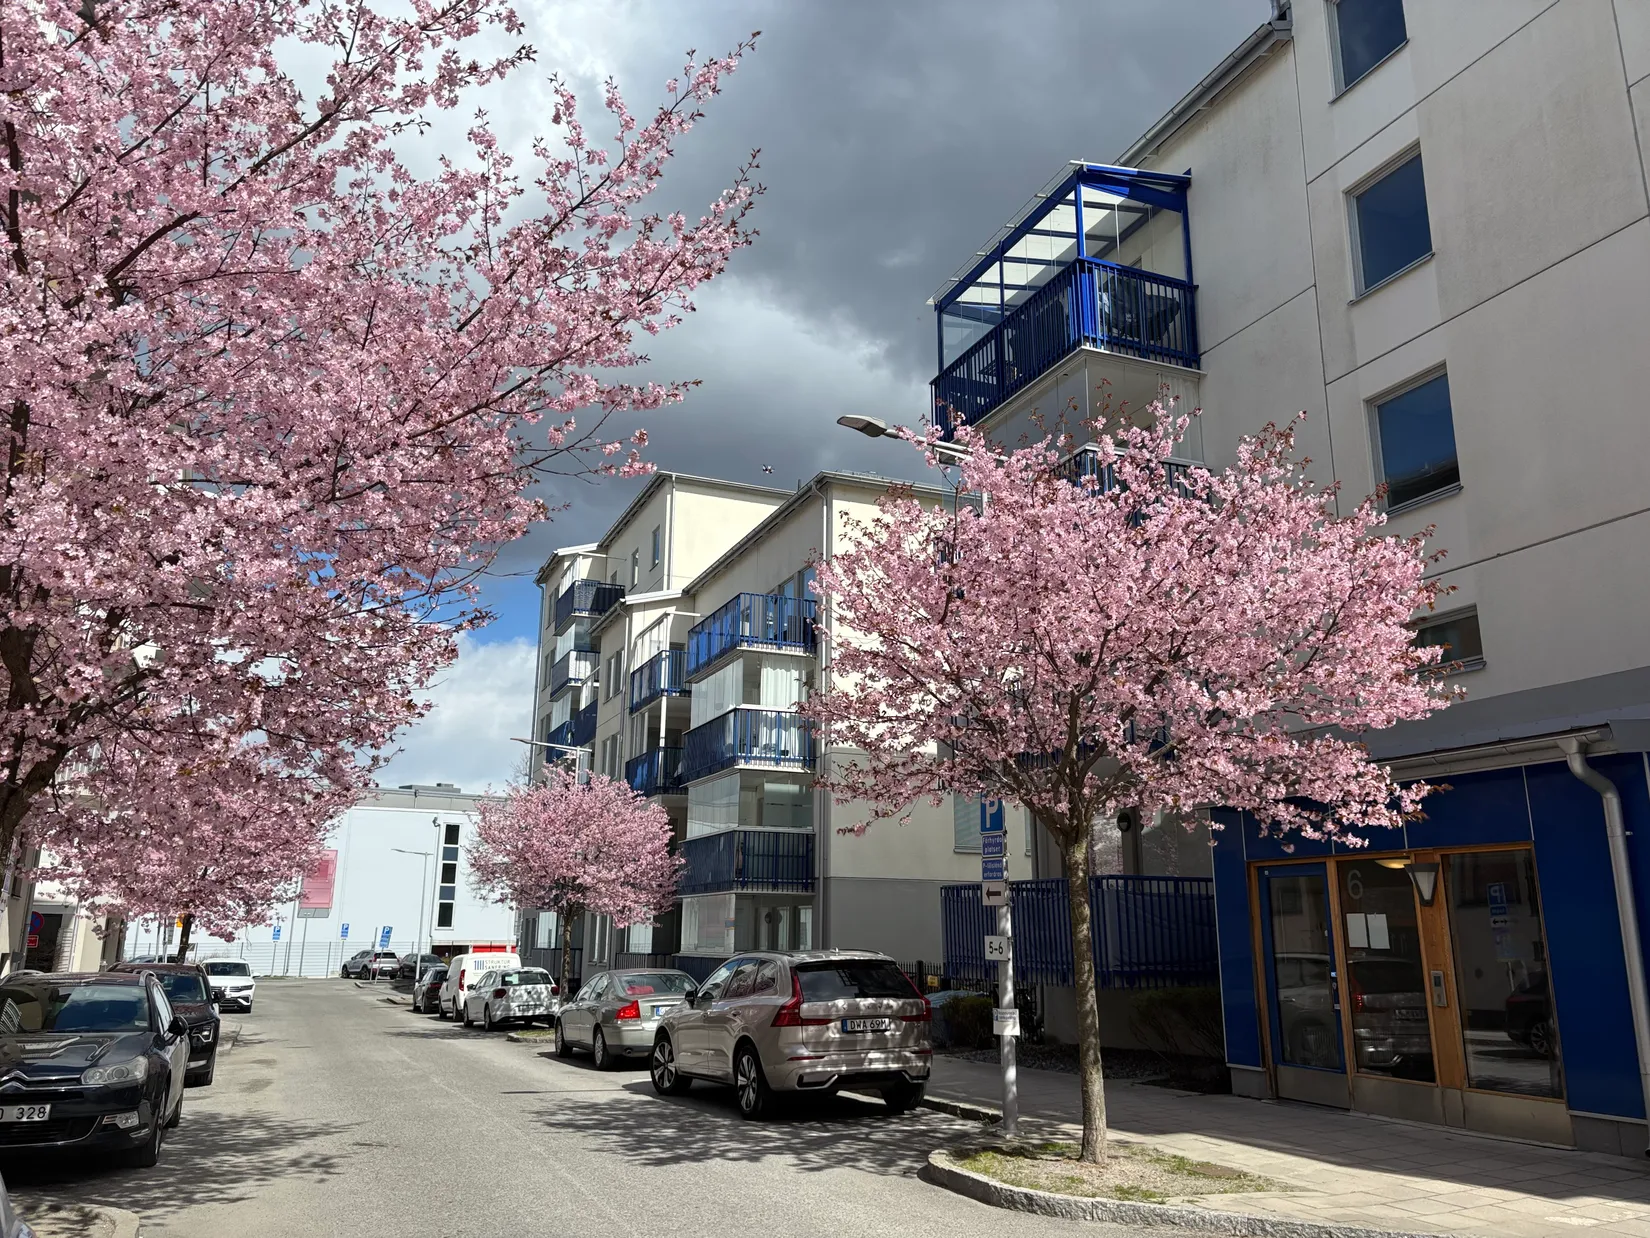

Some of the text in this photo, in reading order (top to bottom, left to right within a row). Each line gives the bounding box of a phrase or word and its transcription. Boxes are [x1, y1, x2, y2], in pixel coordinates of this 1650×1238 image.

[986, 795, 999, 828] P
[1347, 869, 1363, 900] 6
[988, 941, 1004, 955] 5-6
[850, 1020, 867, 1030] DWA
[16, 1106, 46, 1120] 328
